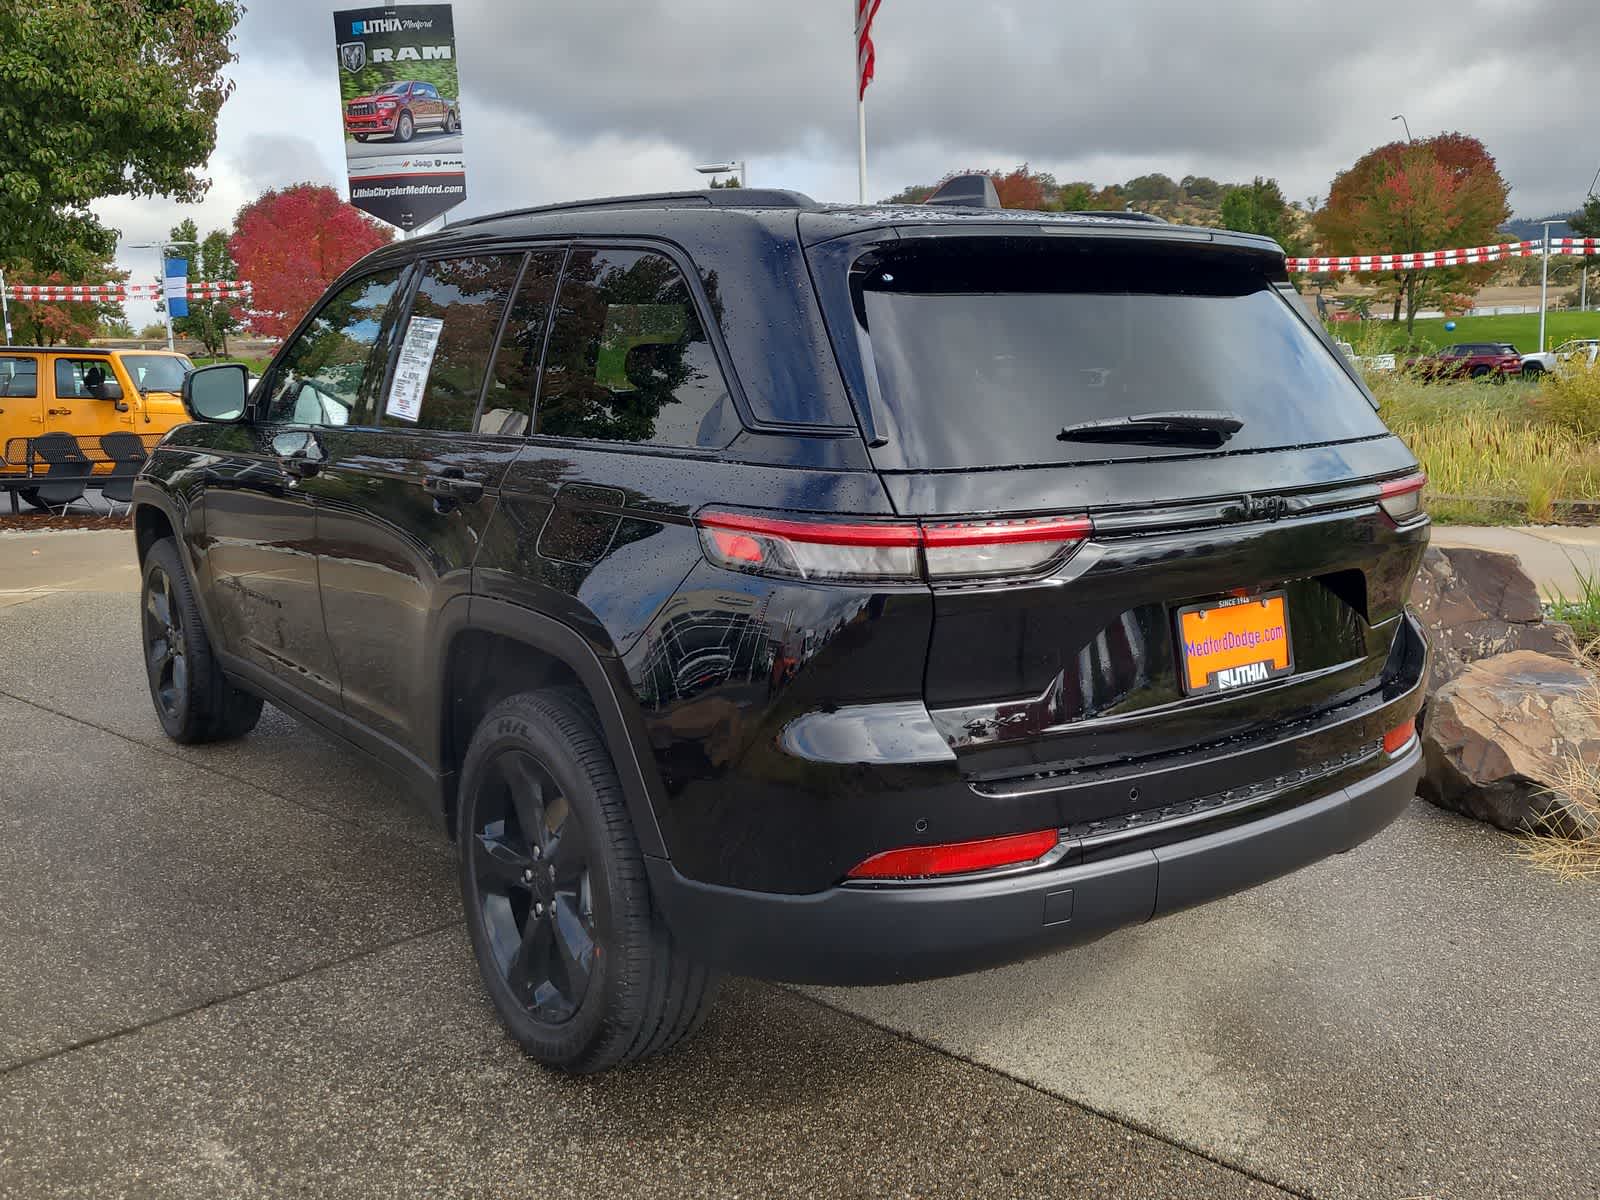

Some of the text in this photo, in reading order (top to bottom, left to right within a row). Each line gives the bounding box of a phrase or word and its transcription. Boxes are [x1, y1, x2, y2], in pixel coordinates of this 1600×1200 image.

[363, 18, 433, 34] LITHIA Medford
[373, 46, 451, 63] RAM
[352, 184, 464, 199] LithiaChryslerMedford.com
[1219, 598, 1236, 608] SINCE
[1184, 625, 1284, 657] MedfordDodge.com
[1230, 661, 1268, 686] LITHIA
